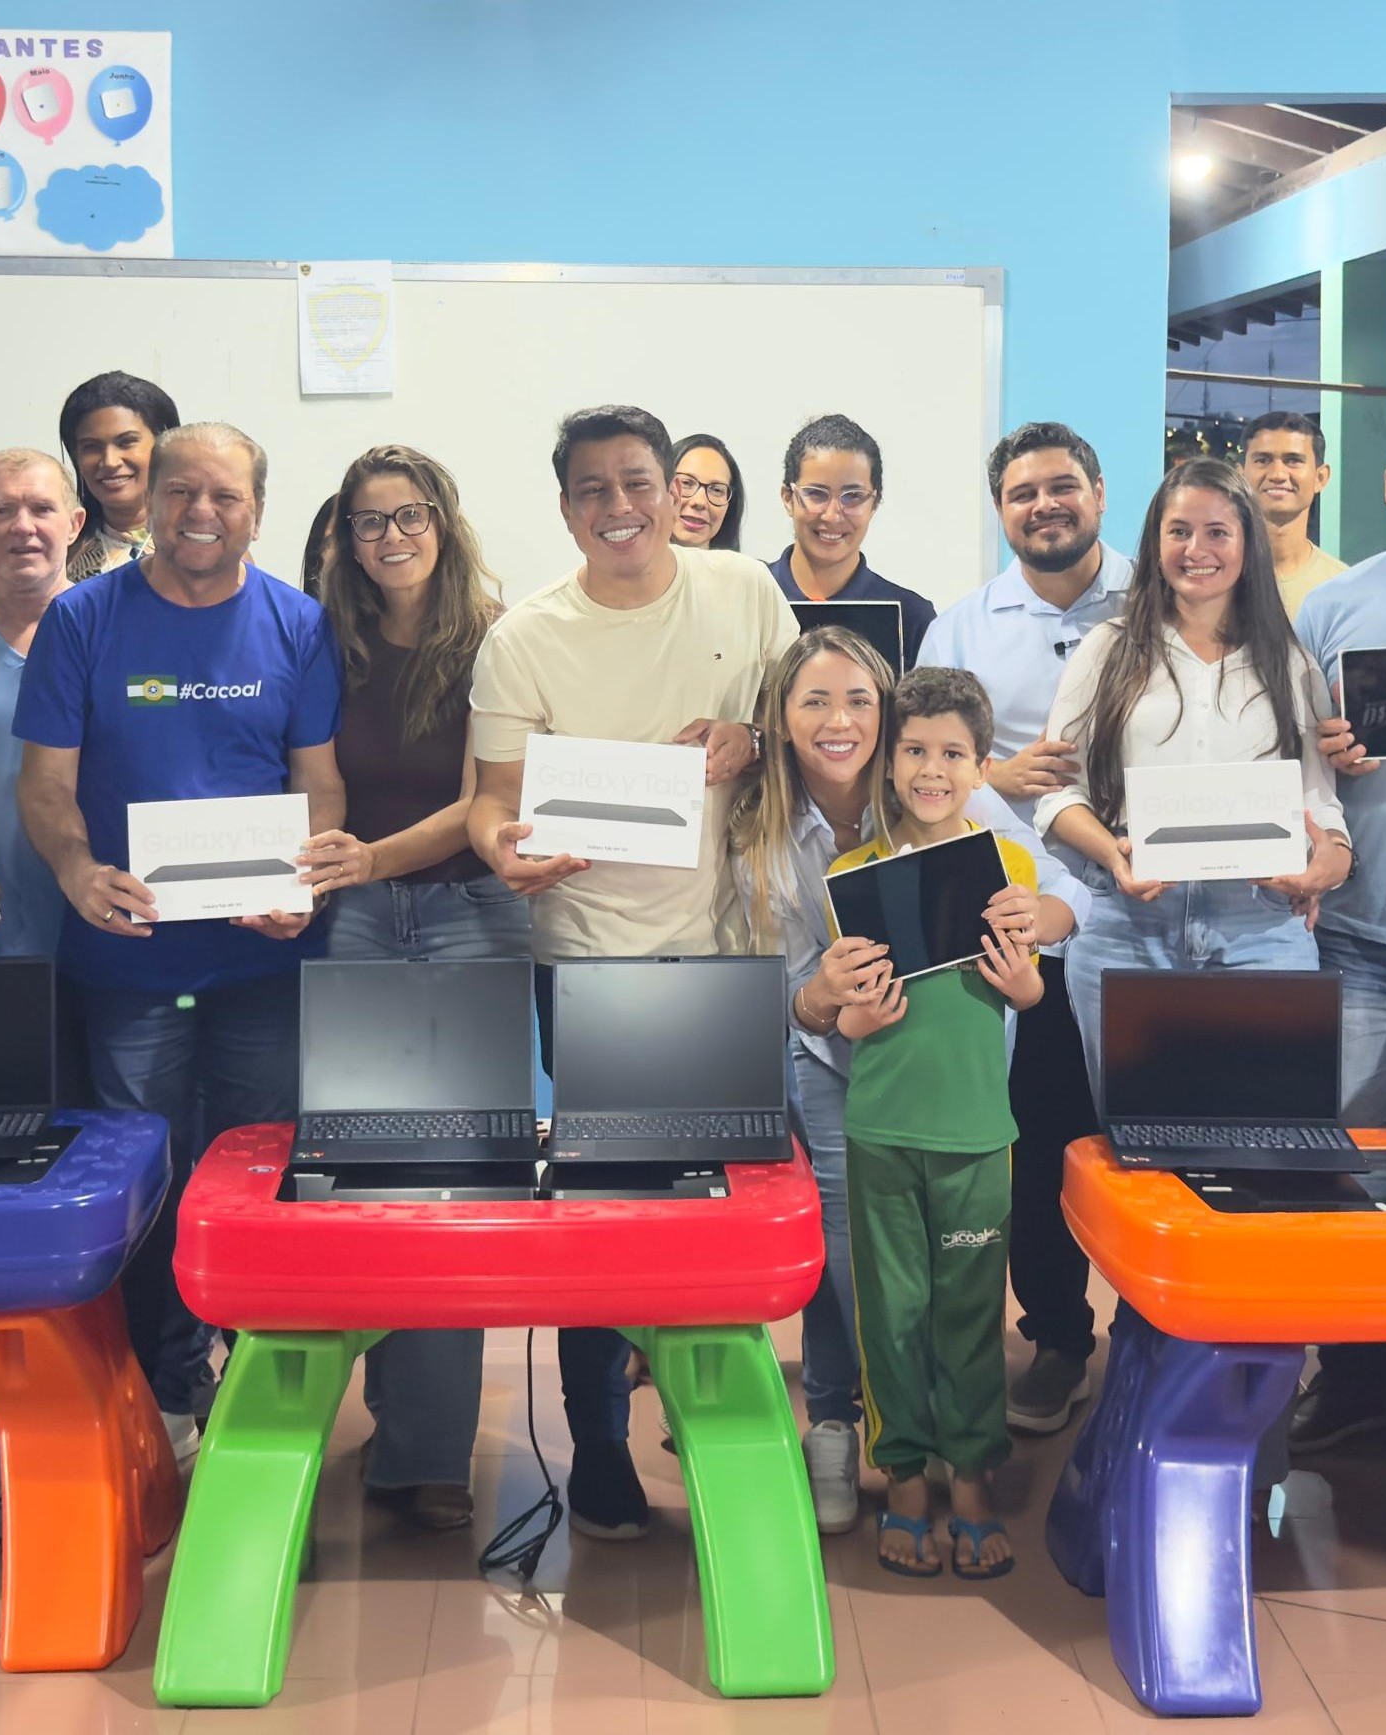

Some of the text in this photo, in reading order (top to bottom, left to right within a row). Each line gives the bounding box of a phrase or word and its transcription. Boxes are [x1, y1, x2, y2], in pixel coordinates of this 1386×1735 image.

[179, 680, 262, 700] #Cacoal
[536, 764, 692, 798] Galaxy Tab
